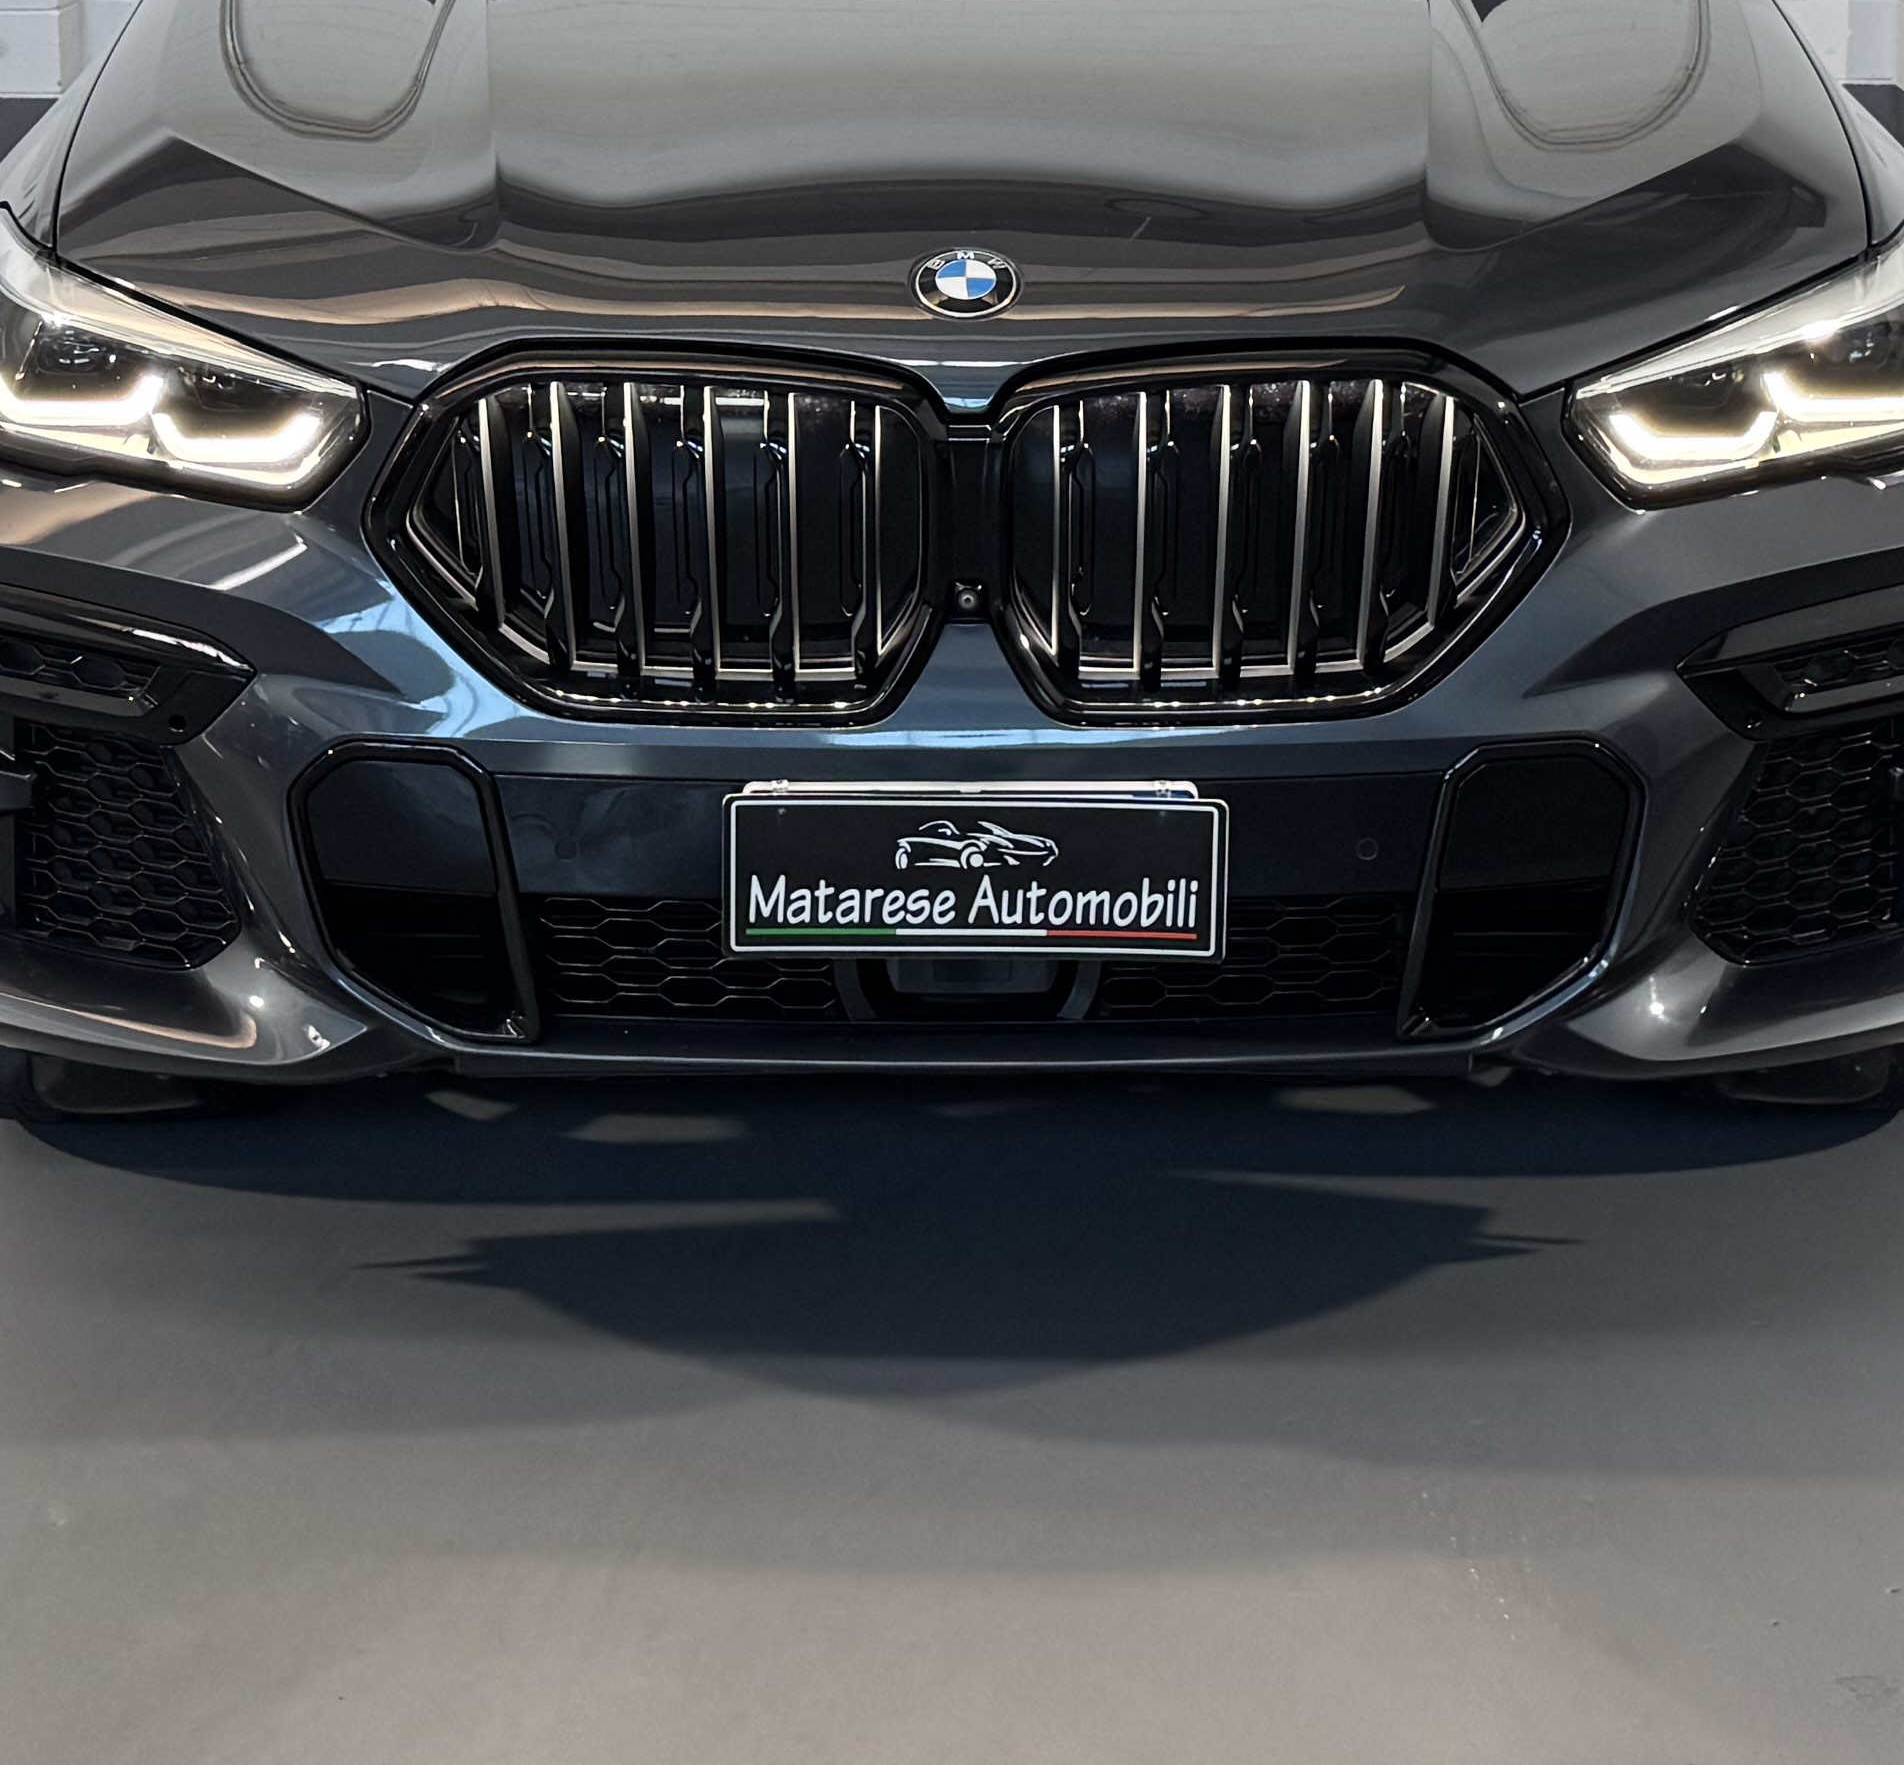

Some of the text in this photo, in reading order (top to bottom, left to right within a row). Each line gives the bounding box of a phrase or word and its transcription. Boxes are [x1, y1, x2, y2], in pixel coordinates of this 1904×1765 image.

[927, 250, 1008, 270] BMW
[747, 874, 1199, 928] Matarese Automobili
